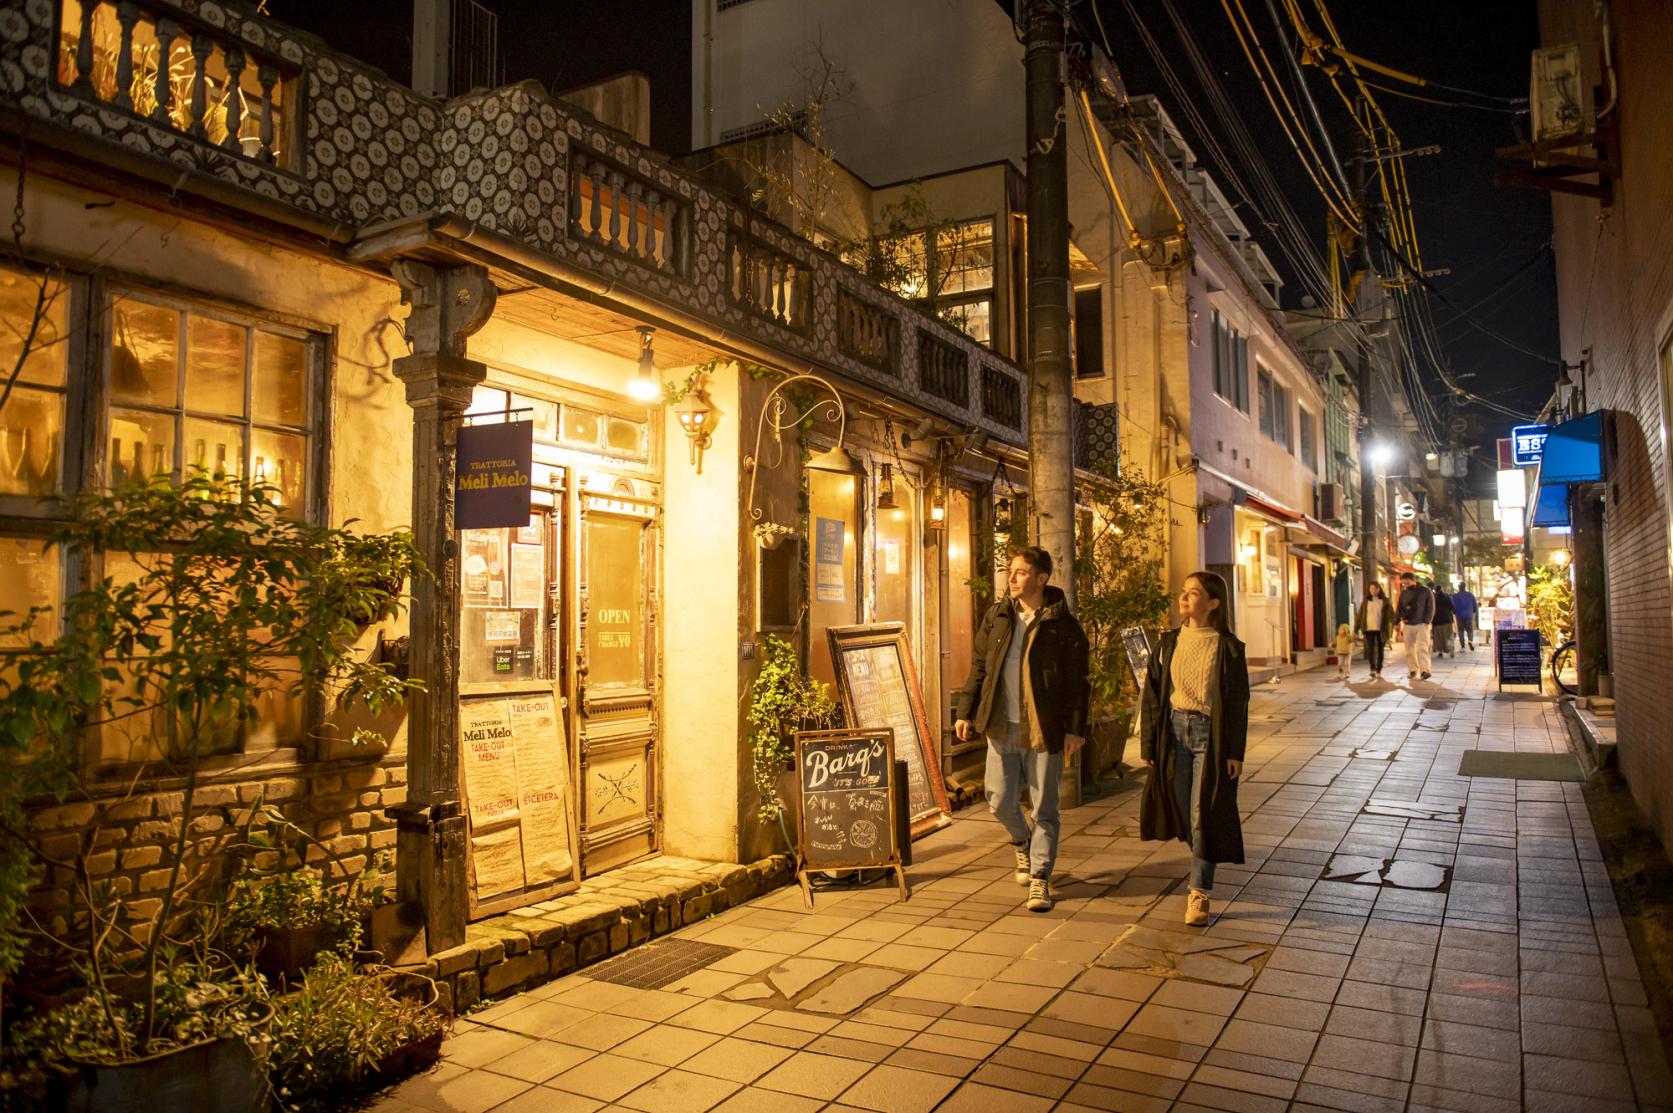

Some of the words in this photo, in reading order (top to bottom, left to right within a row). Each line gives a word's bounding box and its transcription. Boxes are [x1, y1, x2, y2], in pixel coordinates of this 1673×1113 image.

[470, 459, 517, 470] TRATTORIA
[458, 473, 489, 490] Meli
[491, 470, 529, 488] Melo
[598, 608, 631, 624] OPEN
[496, 655, 510, 663] Uber
[496, 663, 511, 671] Eats
[512, 702, 549, 713] TAKE-OUT
[470, 719, 502, 728] TRATTORIA
[463, 729, 486, 742] Meli
[487, 727, 512, 740] Melo
[471, 741, 505, 753] TAKE-OUT
[478, 752, 500, 762] MENU
[805, 739, 885, 788] Barq's
[524, 792, 559, 805] ETCETERA
[475, 799, 513, 813] TAKE-OUT
